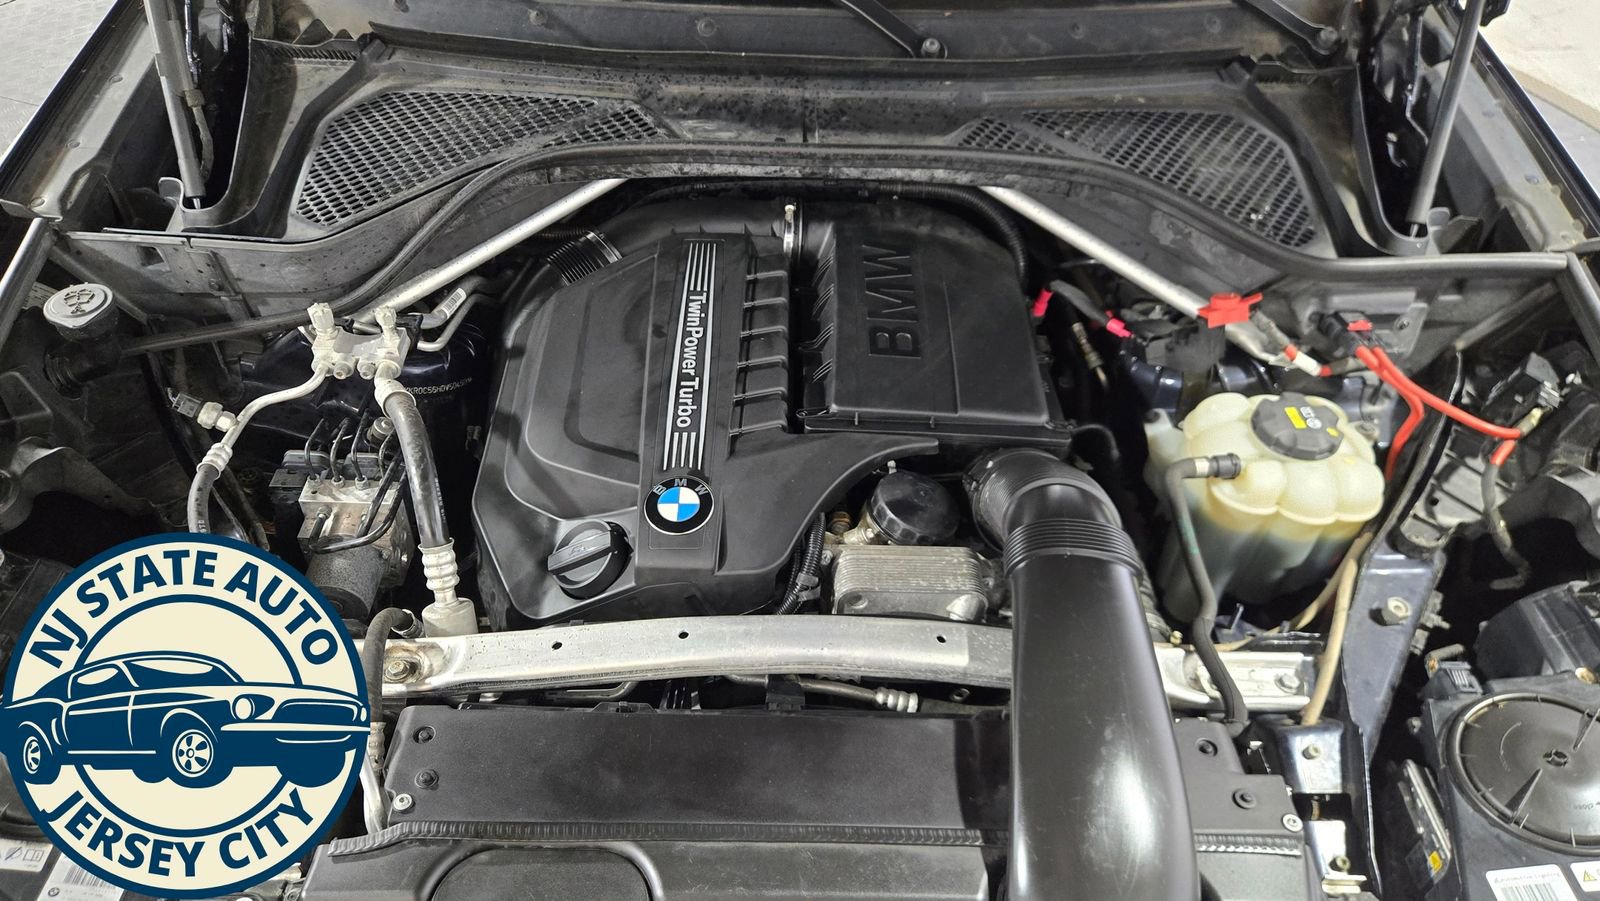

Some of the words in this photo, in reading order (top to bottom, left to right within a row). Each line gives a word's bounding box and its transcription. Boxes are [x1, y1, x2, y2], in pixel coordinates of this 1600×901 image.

[681, 292, 706, 375] TwinPower
[862, 244, 921, 360] BMW
[676, 376, 699, 428] Turbo
[653, 478, 709, 496] BMW
